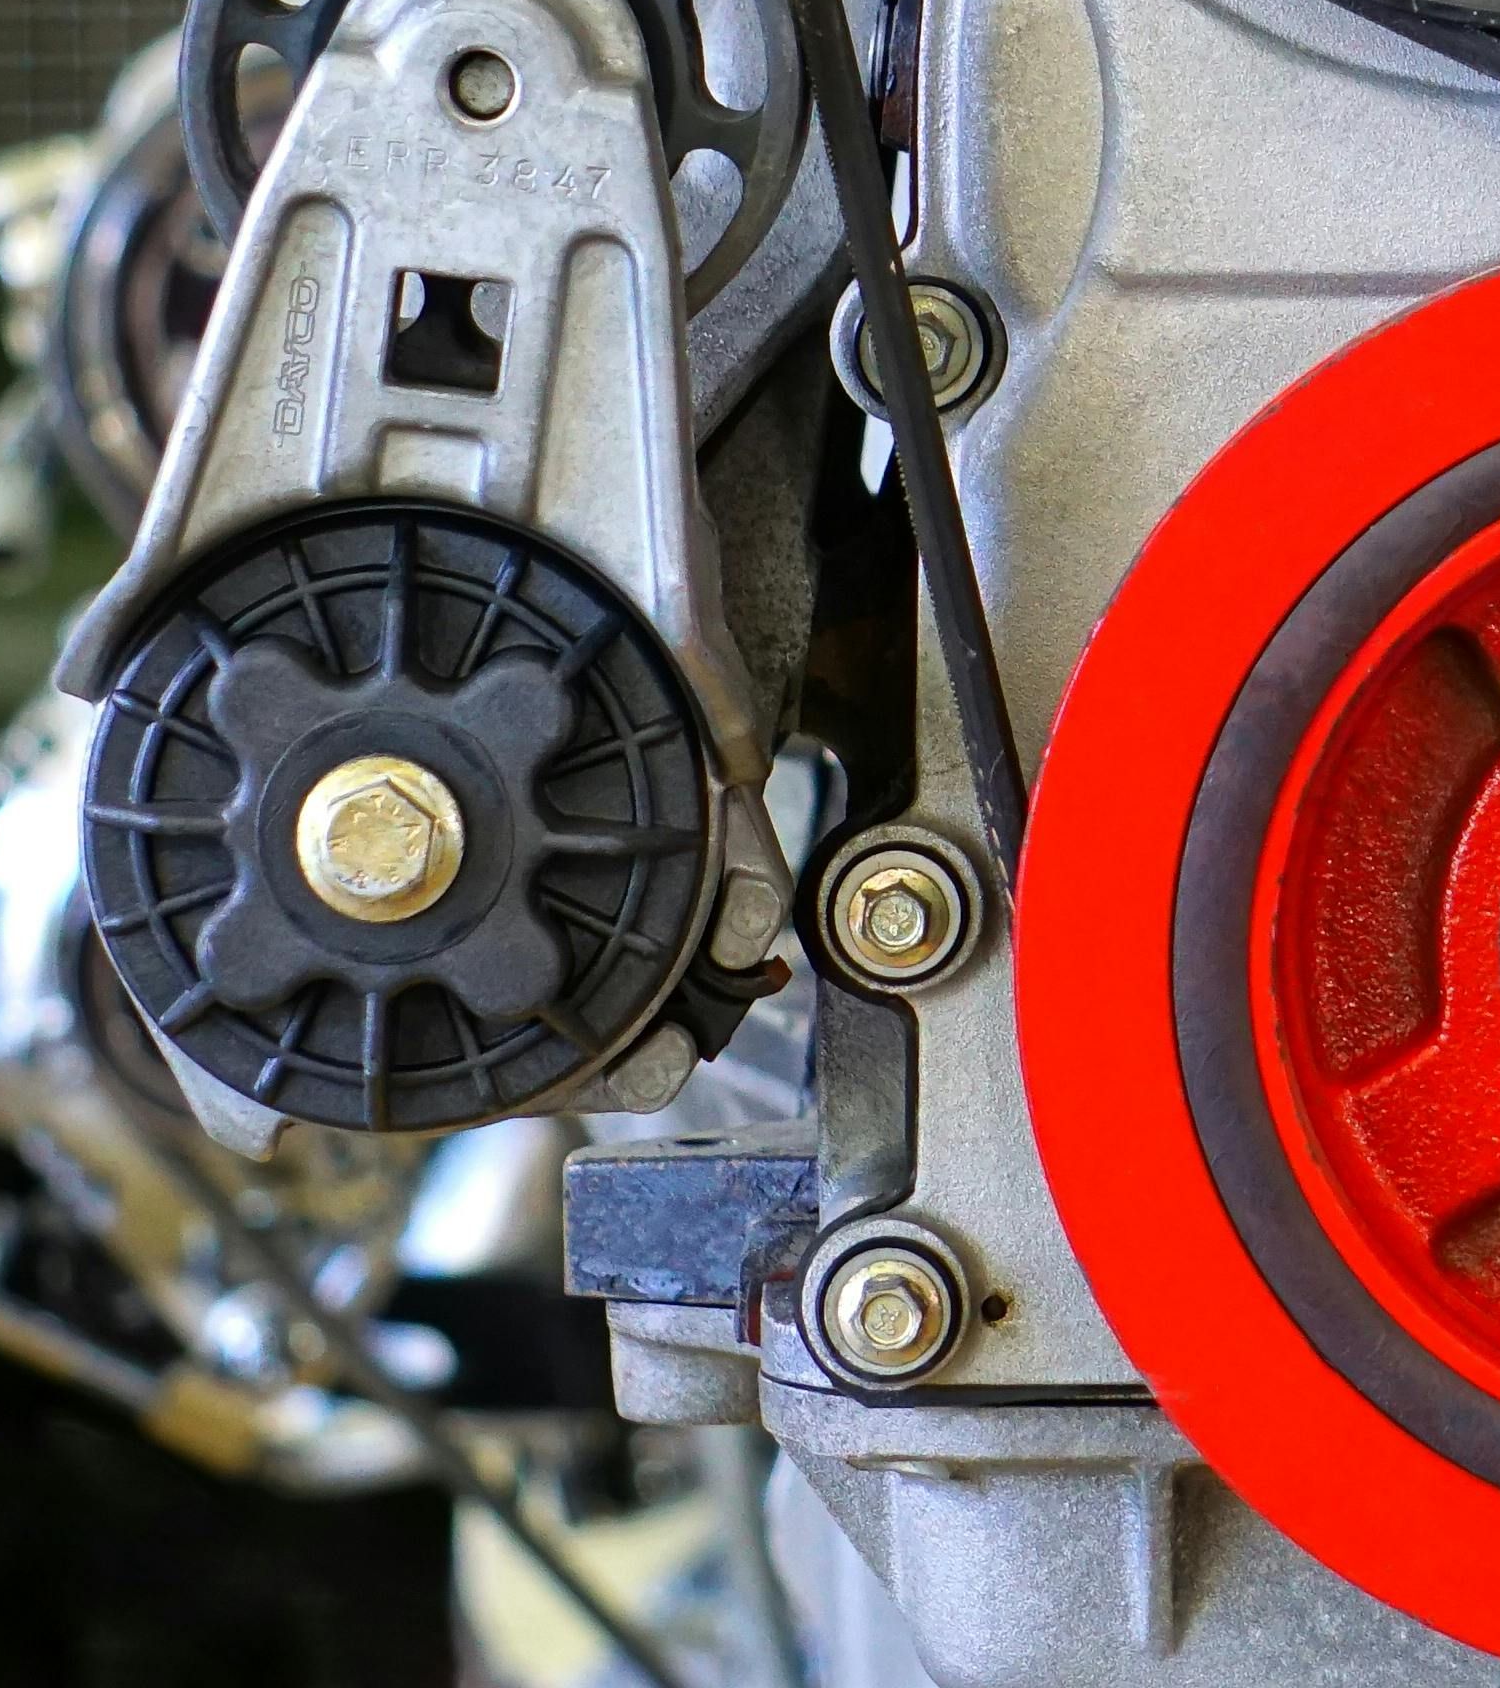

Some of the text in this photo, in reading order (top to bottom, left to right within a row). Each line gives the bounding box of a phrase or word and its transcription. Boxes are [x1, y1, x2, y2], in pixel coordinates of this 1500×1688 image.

[344, 135, 451, 180] ERR
[476, 146, 612, 201] 3847
[272, 268, 319, 436] DAYCO
